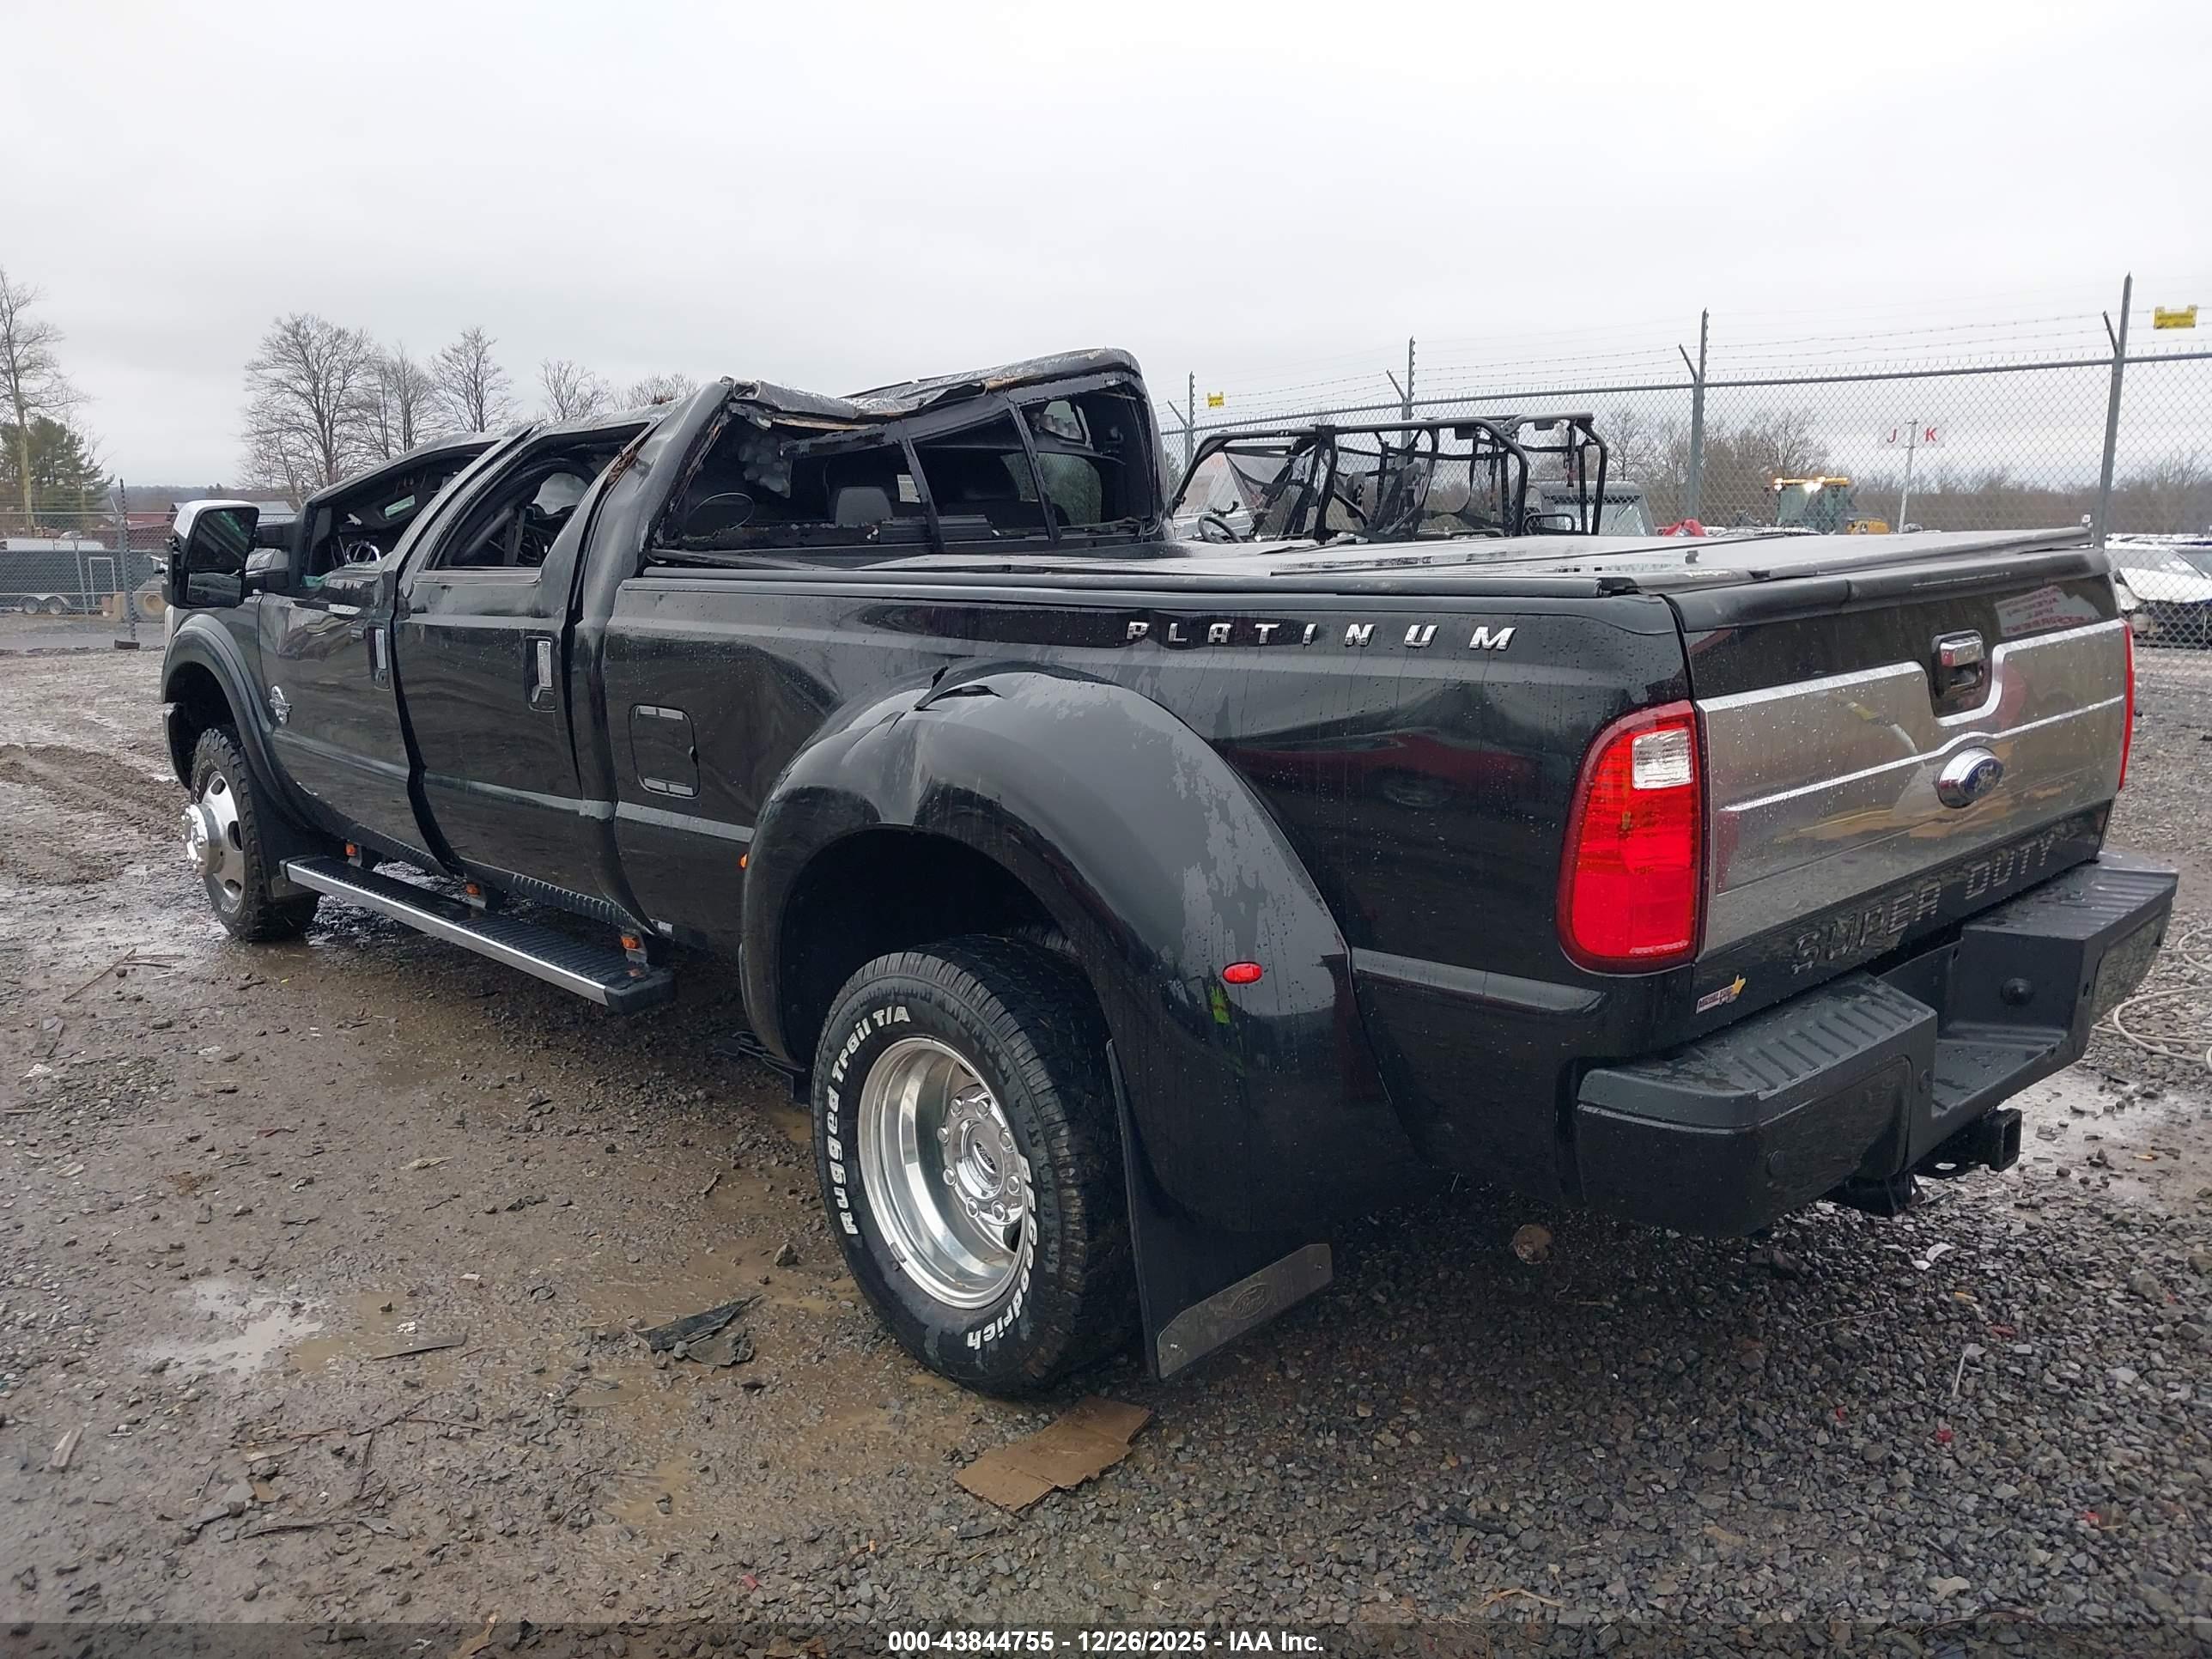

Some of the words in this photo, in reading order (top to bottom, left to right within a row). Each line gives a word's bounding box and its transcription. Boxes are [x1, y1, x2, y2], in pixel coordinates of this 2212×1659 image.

[1886, 428, 1897, 444] J
[1924, 428, 1938, 442] K
[1126, 621, 1517, 651] PLATINUM
[1791, 878, 1942, 975] SUPER
[1964, 833, 2057, 902] DUTY
[872, 1006, 911, 1028] T/A
[831, 1018, 872, 1083] Trail
[827, 1085, 860, 1235] Rugged
[966, 1153, 1037, 1351] BFGoodrich
